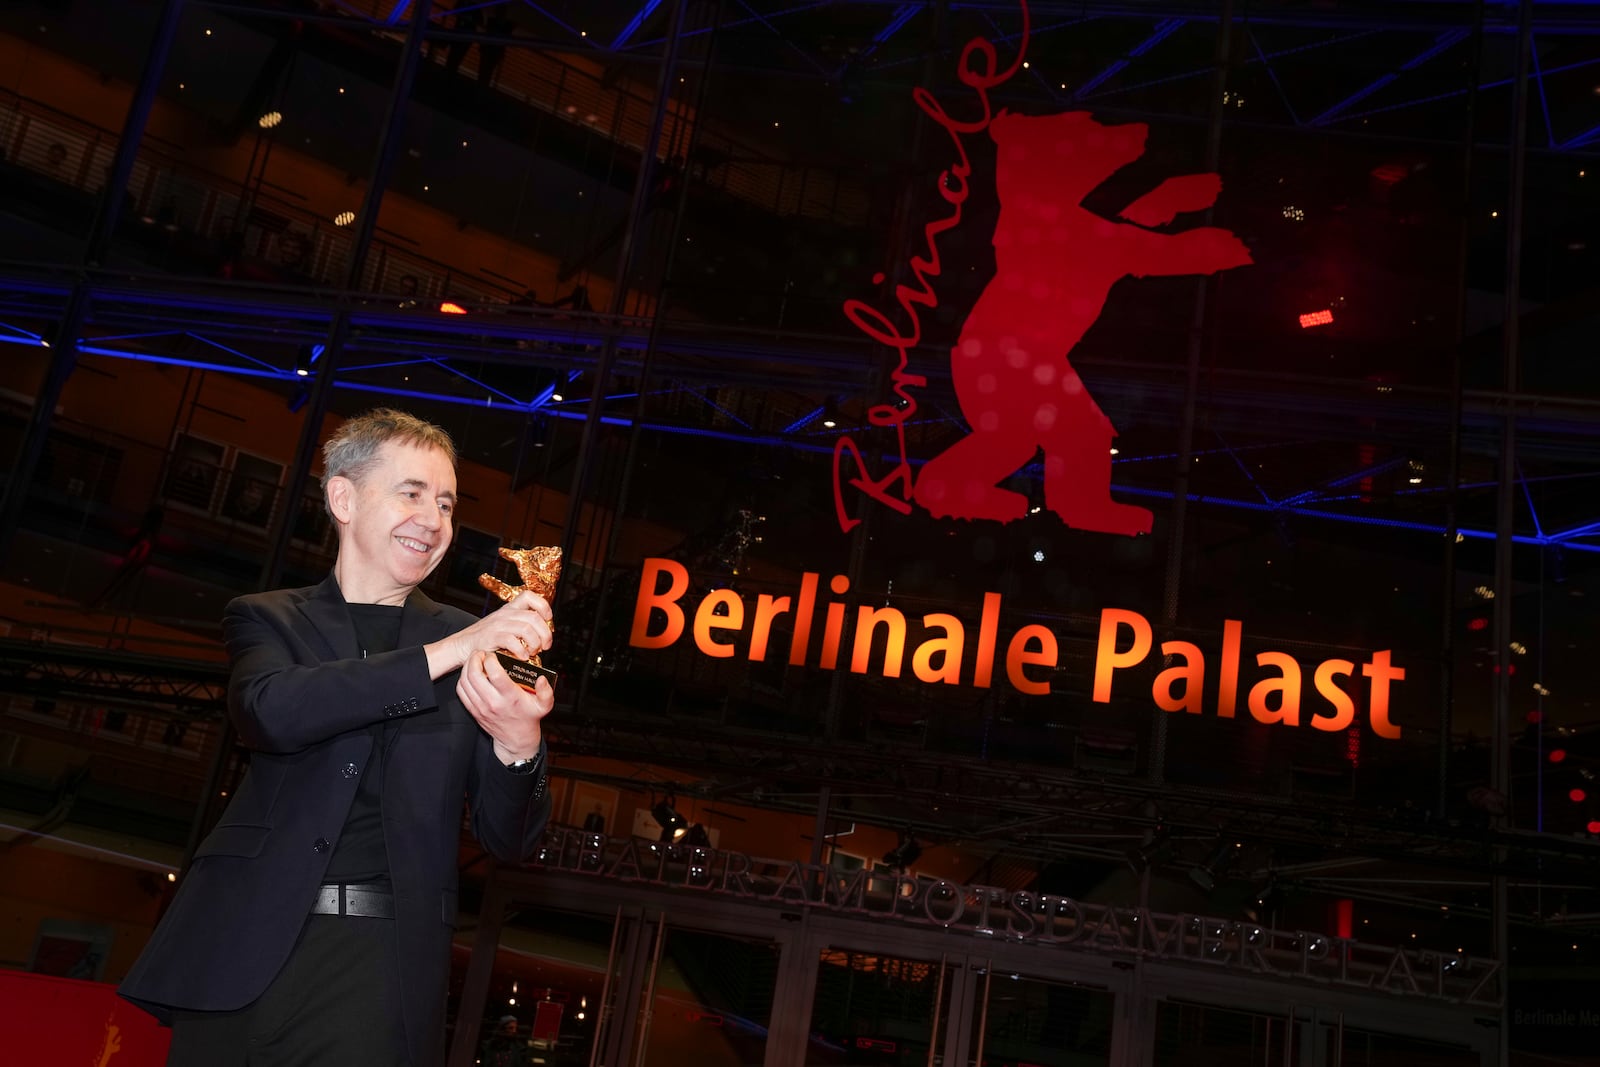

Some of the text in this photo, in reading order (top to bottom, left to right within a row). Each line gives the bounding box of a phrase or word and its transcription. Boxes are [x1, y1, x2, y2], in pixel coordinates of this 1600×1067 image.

[831, 0, 1030, 535] Berlinale
[628, 556, 1406, 740] Berlinale Palast
[767, 860, 870, 912] AM
[886, 872, 1276, 975] POTSDAMER
[1297, 929, 1504, 1008] PLATZ
[1514, 1007, 1576, 1027] Berlinale
